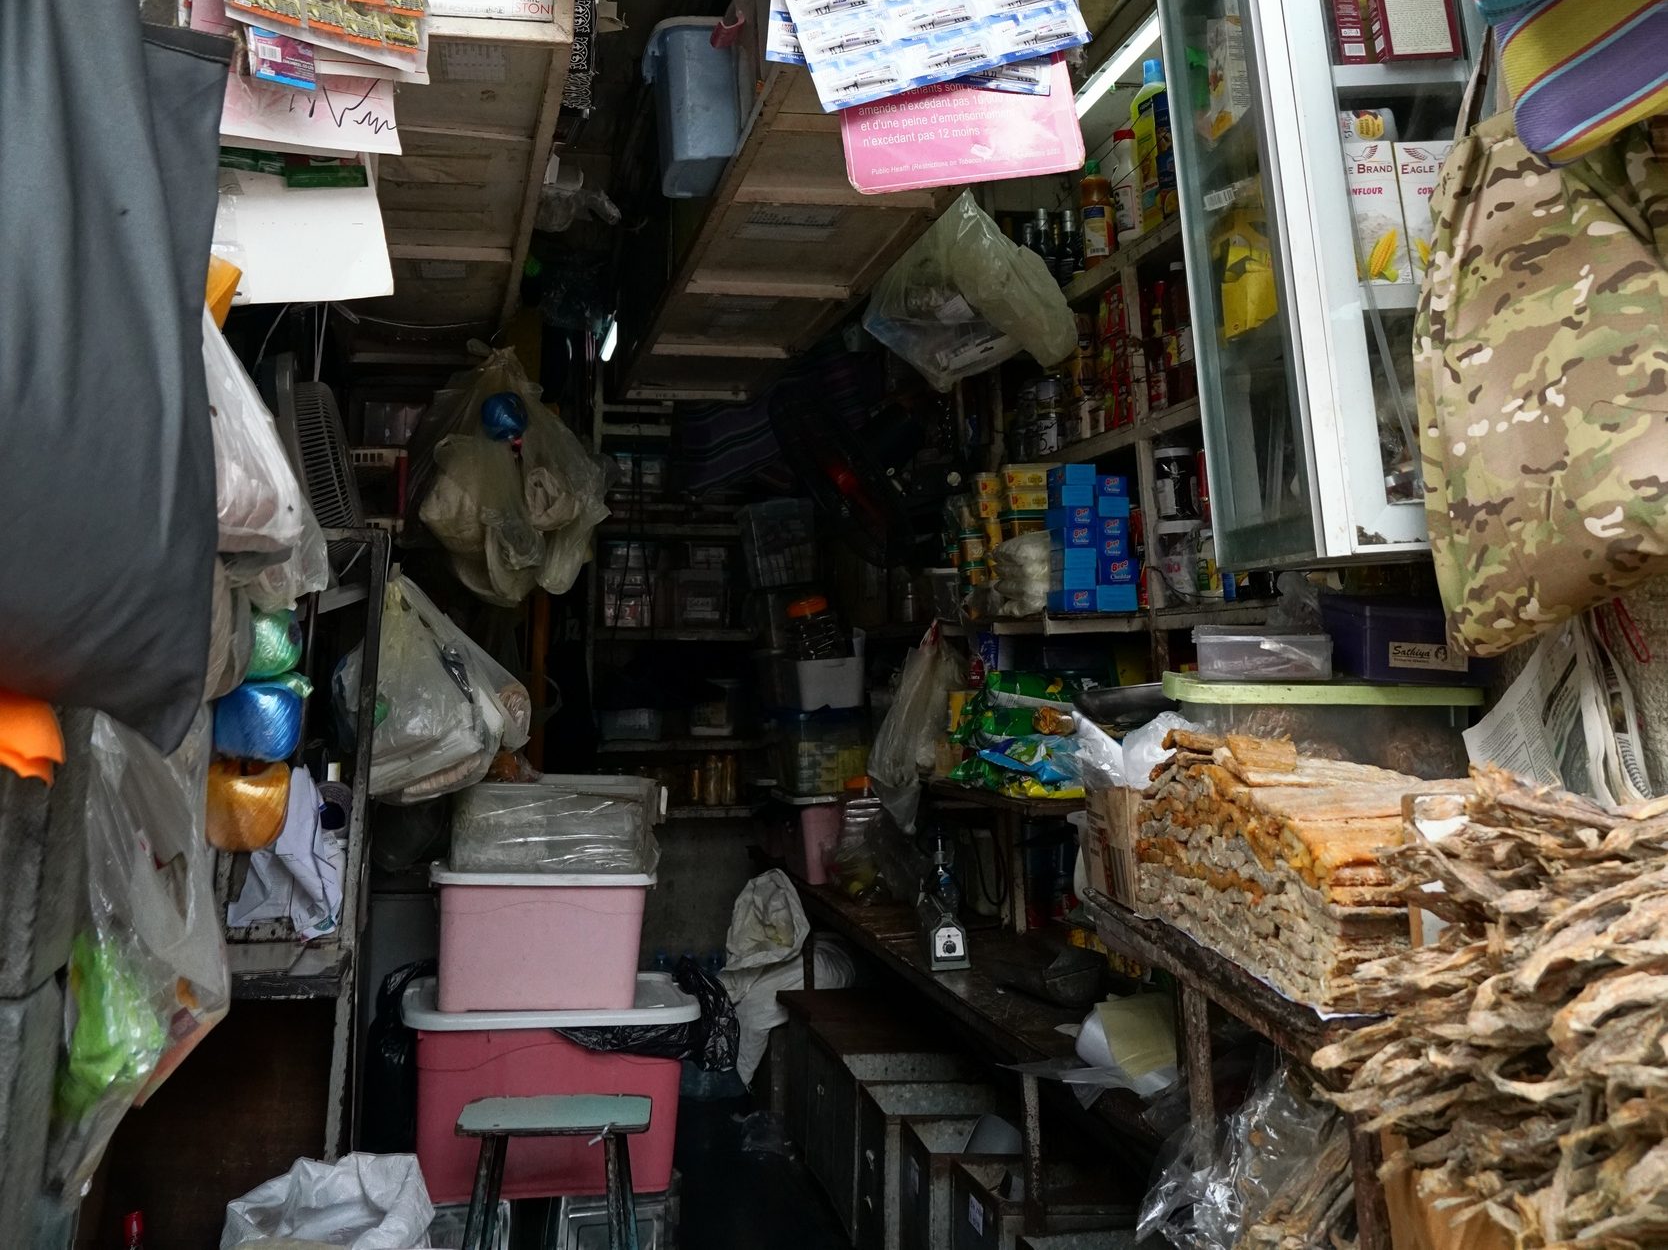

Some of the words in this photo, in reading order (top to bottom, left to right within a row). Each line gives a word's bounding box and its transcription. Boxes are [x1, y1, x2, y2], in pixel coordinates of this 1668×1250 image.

[858, 102, 899, 117] amende
[952, 96, 970, 110] pas
[860, 121, 870, 132] et
[872, 117, 899, 131] d'une
[901, 115, 928, 131] peine
[863, 132, 915, 148] n'excédant
[917, 130, 936, 144] pas
[938, 127, 950, 140] 12
[952, 125, 981, 139] moins
[871, 165, 890, 175] Public
[1357, 163, 1393, 174] BRAND
[1401, 163, 1435, 174] EAGLE
[1392, 645, 1431, 658] Sathiya
